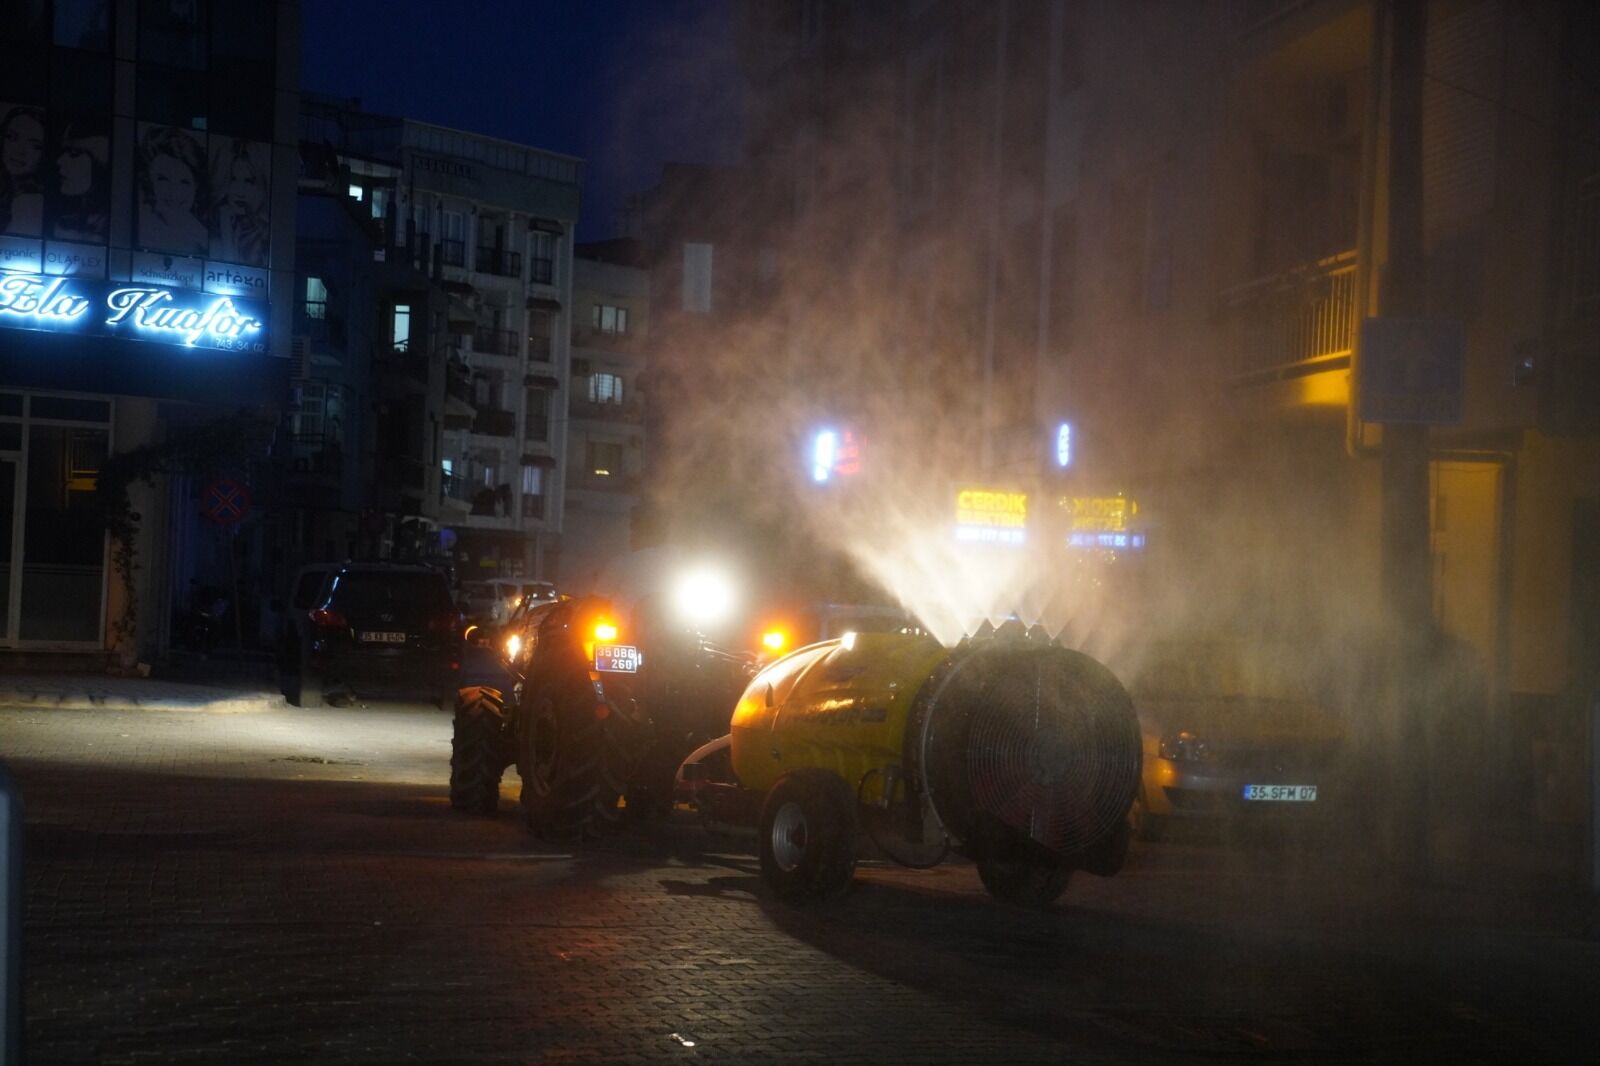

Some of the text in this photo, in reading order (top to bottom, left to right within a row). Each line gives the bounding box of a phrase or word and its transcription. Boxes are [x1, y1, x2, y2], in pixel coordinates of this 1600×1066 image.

[46, 252, 101, 267] OLAPLEX
[0, 274, 90, 320] Ela
[598, 647, 612, 657] 35
[611, 659, 632, 670] 260
[1250, 786, 1316, 800] 35 SFM 07
